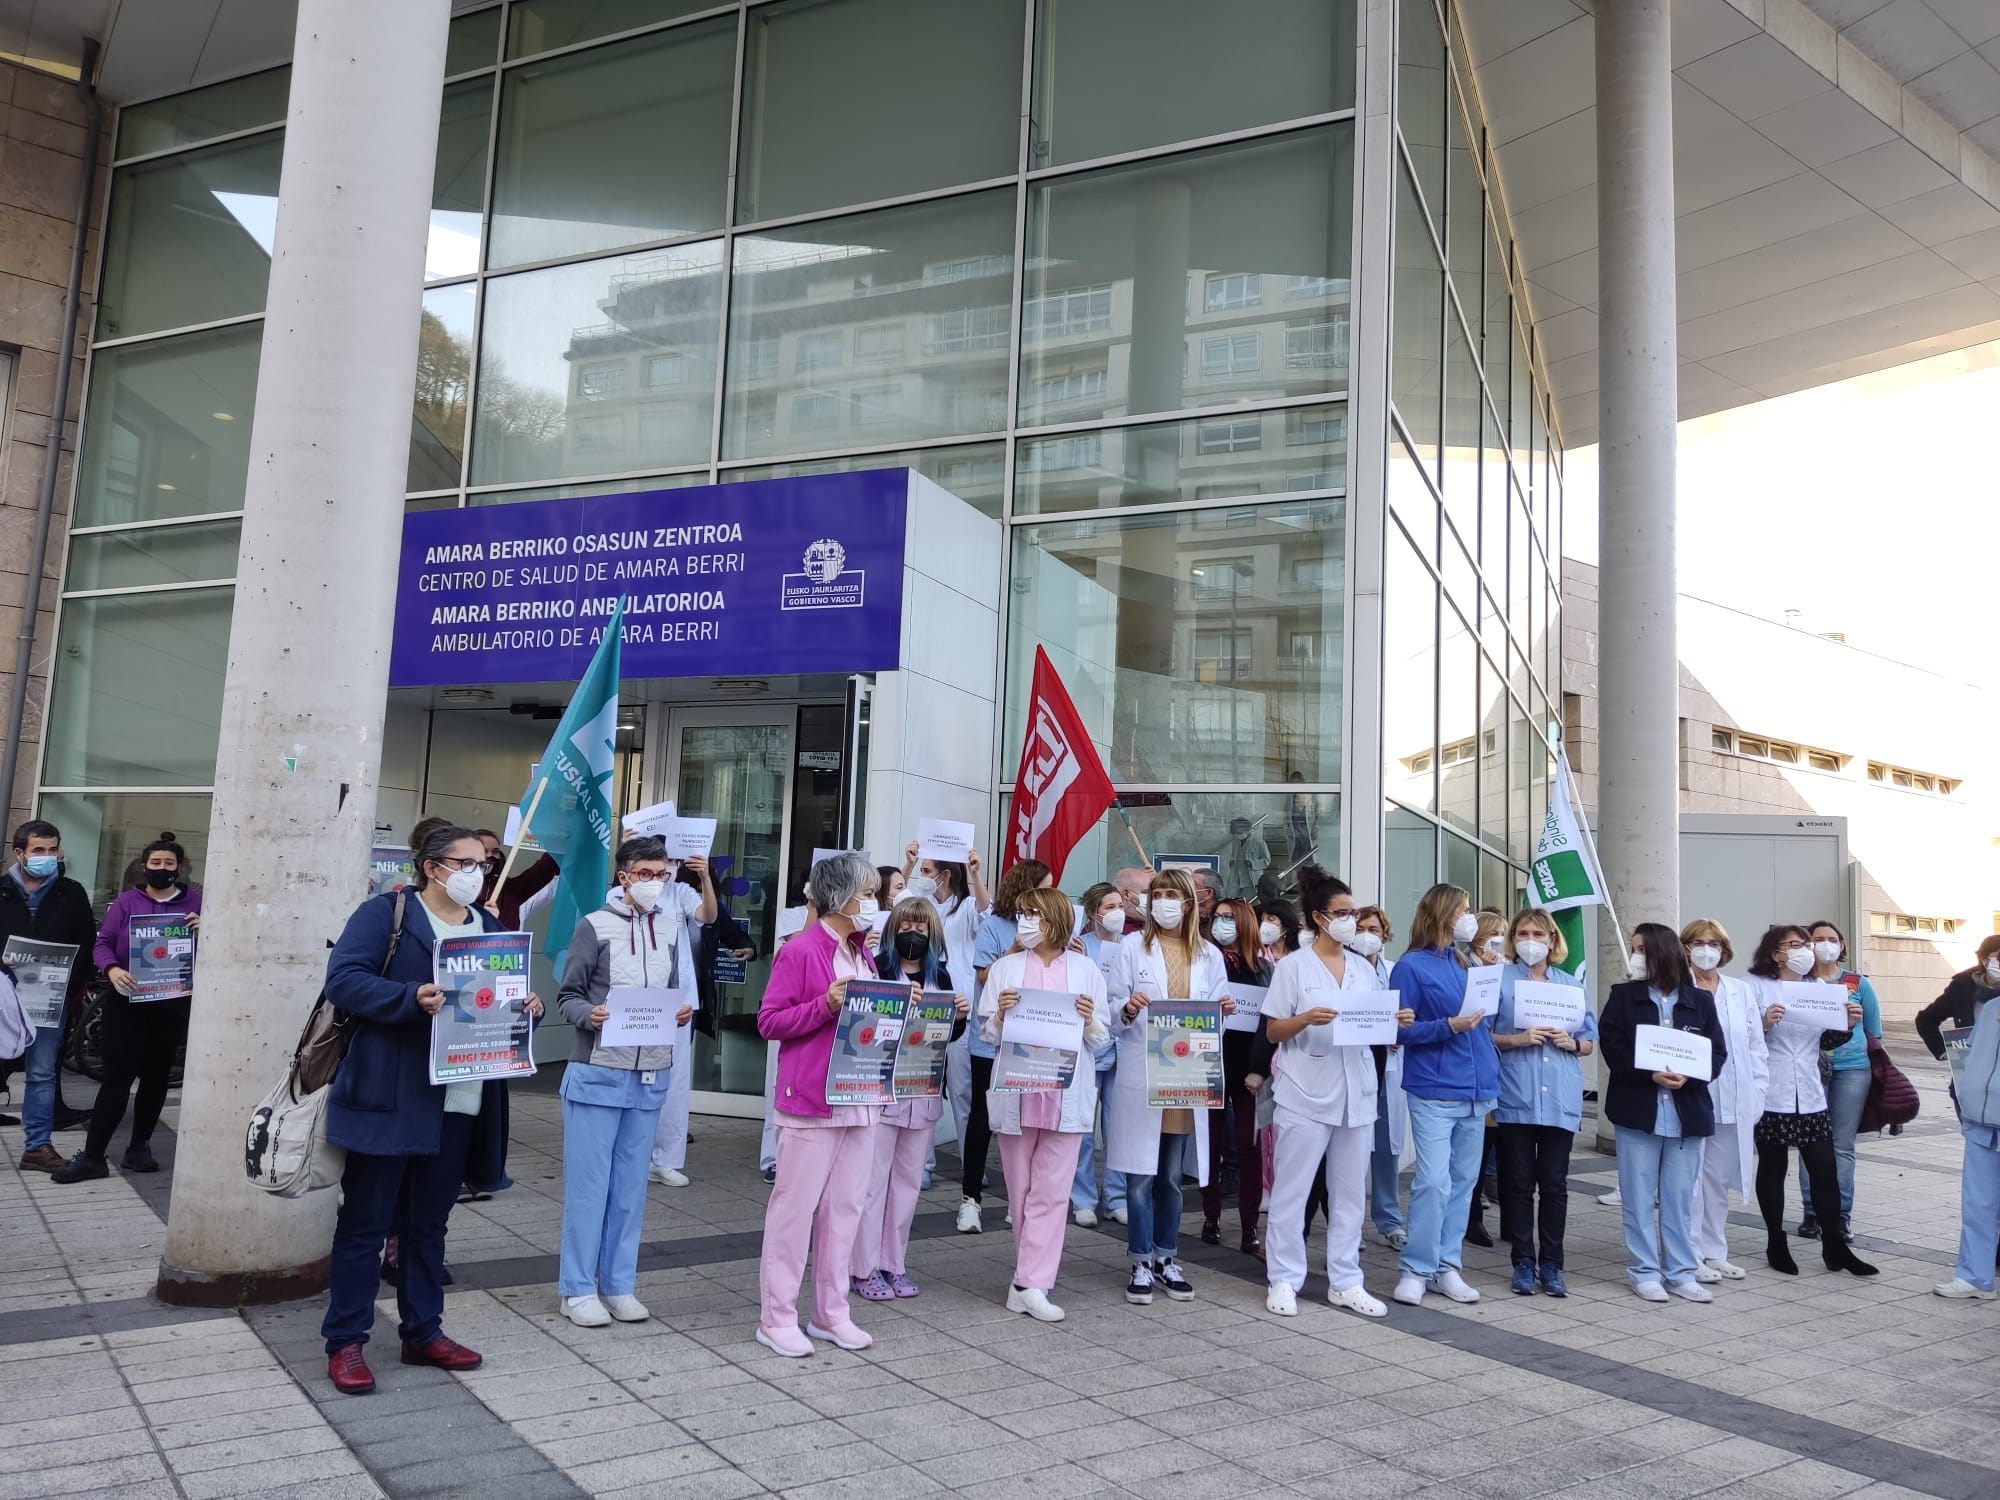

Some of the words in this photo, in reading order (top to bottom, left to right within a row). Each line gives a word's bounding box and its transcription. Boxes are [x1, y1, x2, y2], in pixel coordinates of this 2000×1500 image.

[425, 544, 484, 564] AMARA
[489, 537, 567, 560] BERRIKO
[572, 530, 648, 553] OSASUN
[653, 523, 742, 547] ZENTROA
[419, 571, 485, 592] CENTRO
[492, 569, 514, 587] DE
[520, 564, 578, 586] SALUD
[585, 562, 608, 581] DE
[614, 558, 679, 579] AMARA
[687, 553, 744, 574] BERRI
[786, 587, 809, 595] EUSKO
[812, 585, 858, 594] JAURLARITZA
[788, 597, 828, 605] GOBIERNO
[830, 596, 855, 604] VASCO
[431, 604, 490, 624] AMARA
[496, 600, 574, 621] BERRIKO
[580, 591, 725, 616] ANBULATORIOA
[431, 629, 554, 652] AMBULATORIO
[560, 627, 584, 647] DE
[661, 621, 719, 642] BERRI
[376, 861, 400, 872] Nik
[135, 927, 160, 938] Nik
[164, 926, 189, 937] BAI!
[9, 952, 37, 963] Nik
[446, 955, 484, 974] Nik
[489, 953, 524, 970] BAI!
[506, 987, 518, 996] EZ!
[848, 997, 874, 1012] Nik
[876, 999, 904, 1015] BAI!
[1235, 998, 1246, 1006] NO
[909, 1006, 922, 1019] ik
[925, 1007, 952, 1019] BAI!
[1153, 1015, 1181, 1028] Nik
[1184, 1015, 1215, 1029] BAI!
[882, 1029, 893, 1037] EZ!
[1951, 1039, 1968, 1049] Ni
[447, 1053, 476, 1064] MUGI
[480, 1050, 518, 1061] ZAITEZ!
[1004, 1079, 1029, 1087] MUGI
